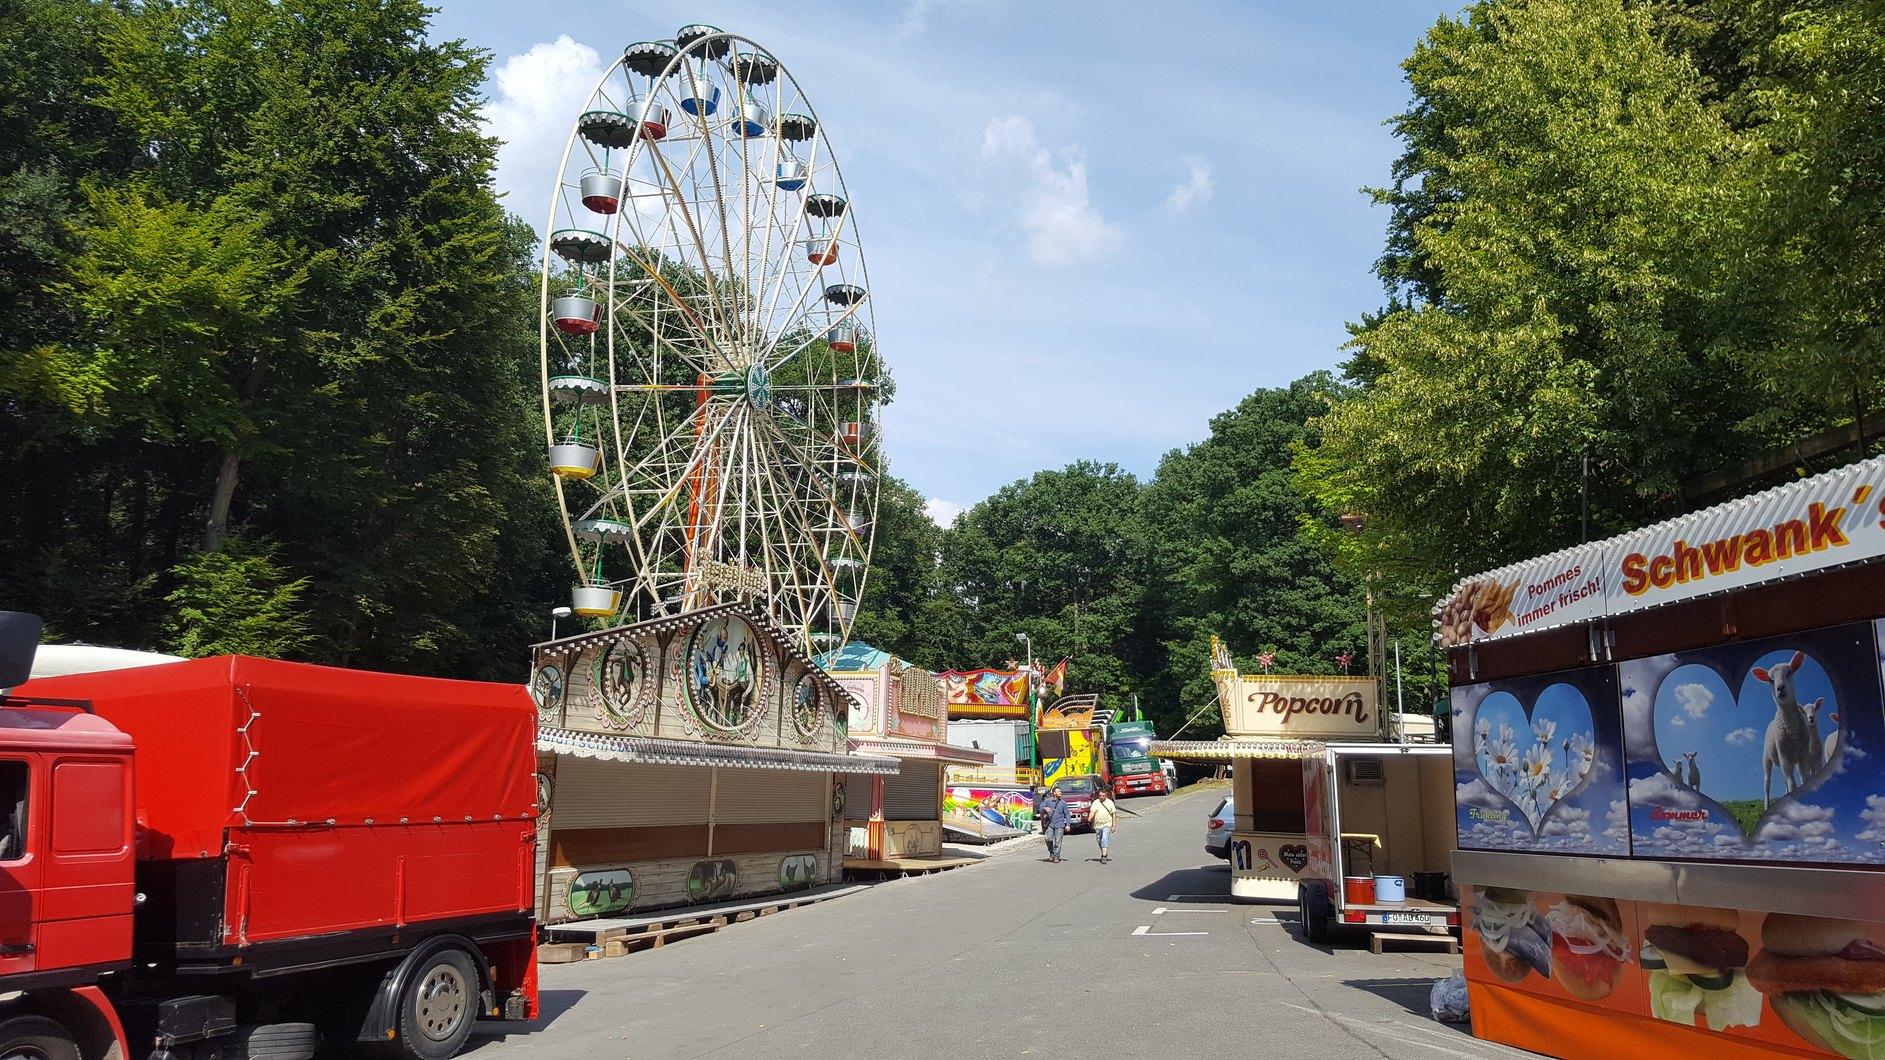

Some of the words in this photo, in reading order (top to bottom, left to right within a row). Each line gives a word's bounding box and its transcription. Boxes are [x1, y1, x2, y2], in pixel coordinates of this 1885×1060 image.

[1621, 485, 1885, 596] Schwank'
[1527, 565, 1581, 599] Pommes
[1517, 601, 1555, 627] immer
[1559, 576, 1601, 608] frisch!
[1247, 691, 1369, 724] Popcorn
[1650, 805, 1708, 821] Sommer
